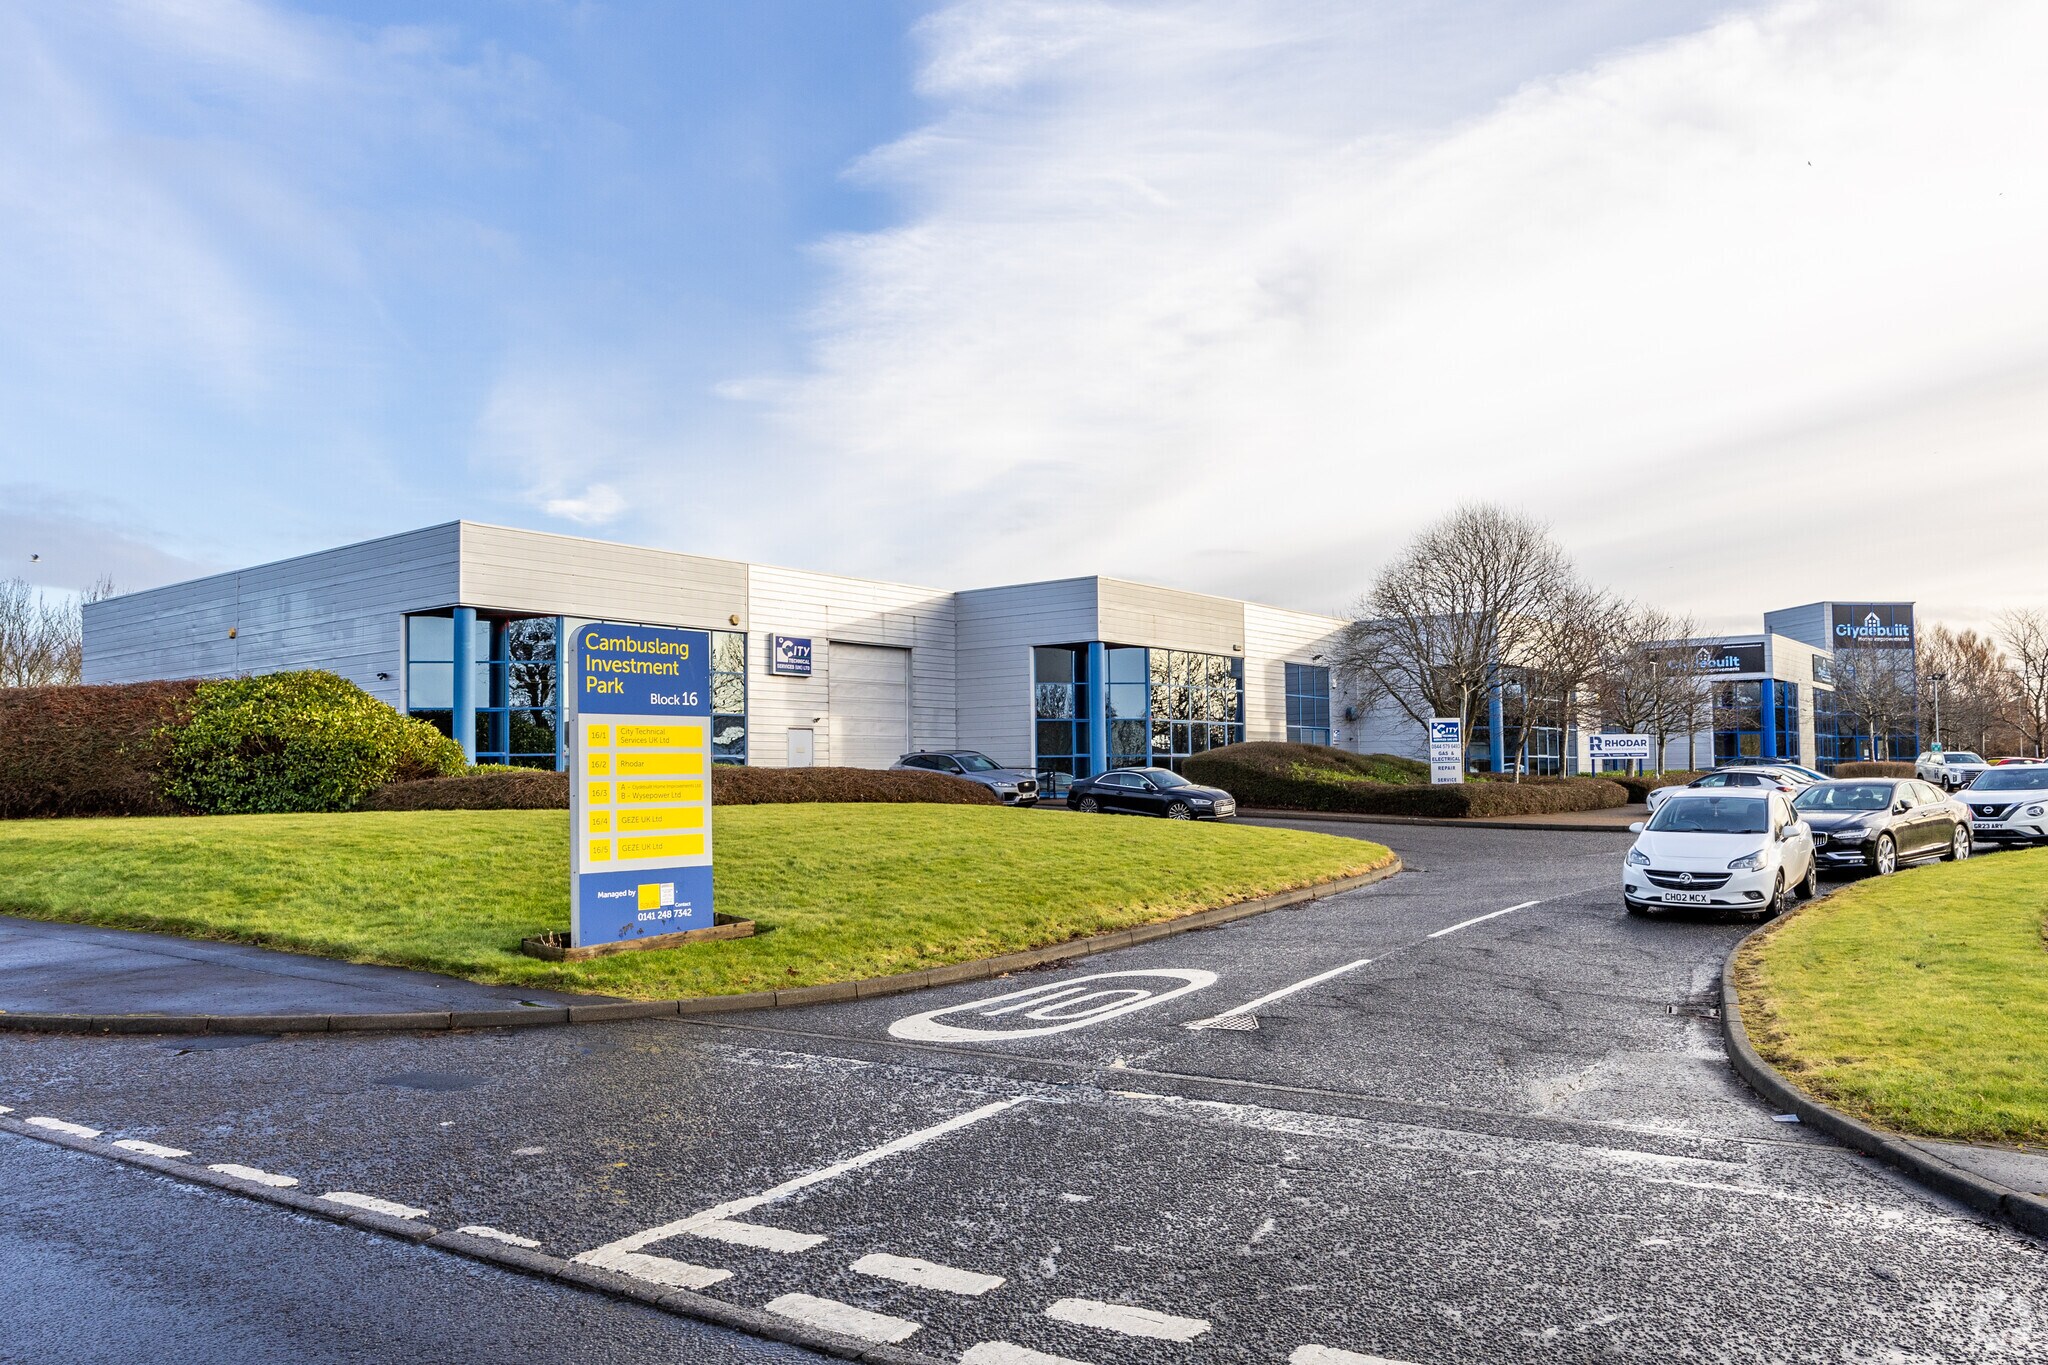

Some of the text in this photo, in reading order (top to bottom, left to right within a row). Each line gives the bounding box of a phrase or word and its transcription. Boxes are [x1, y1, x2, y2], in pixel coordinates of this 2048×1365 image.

[1836, 624, 1910, 638] Clydebuilt
[585, 632, 689, 660] Cambuslang
[782, 640, 810, 657] CITY
[586, 654, 679, 676] Investment
[586, 676, 624, 694] Park
[650, 692, 698, 706] Block 16
[1436, 724, 1458, 734] CITY
[597, 890, 636, 899] Managed by
[1665, 893, 1688, 901] CH02
[638, 908, 692, 921] 0141 248 7342
